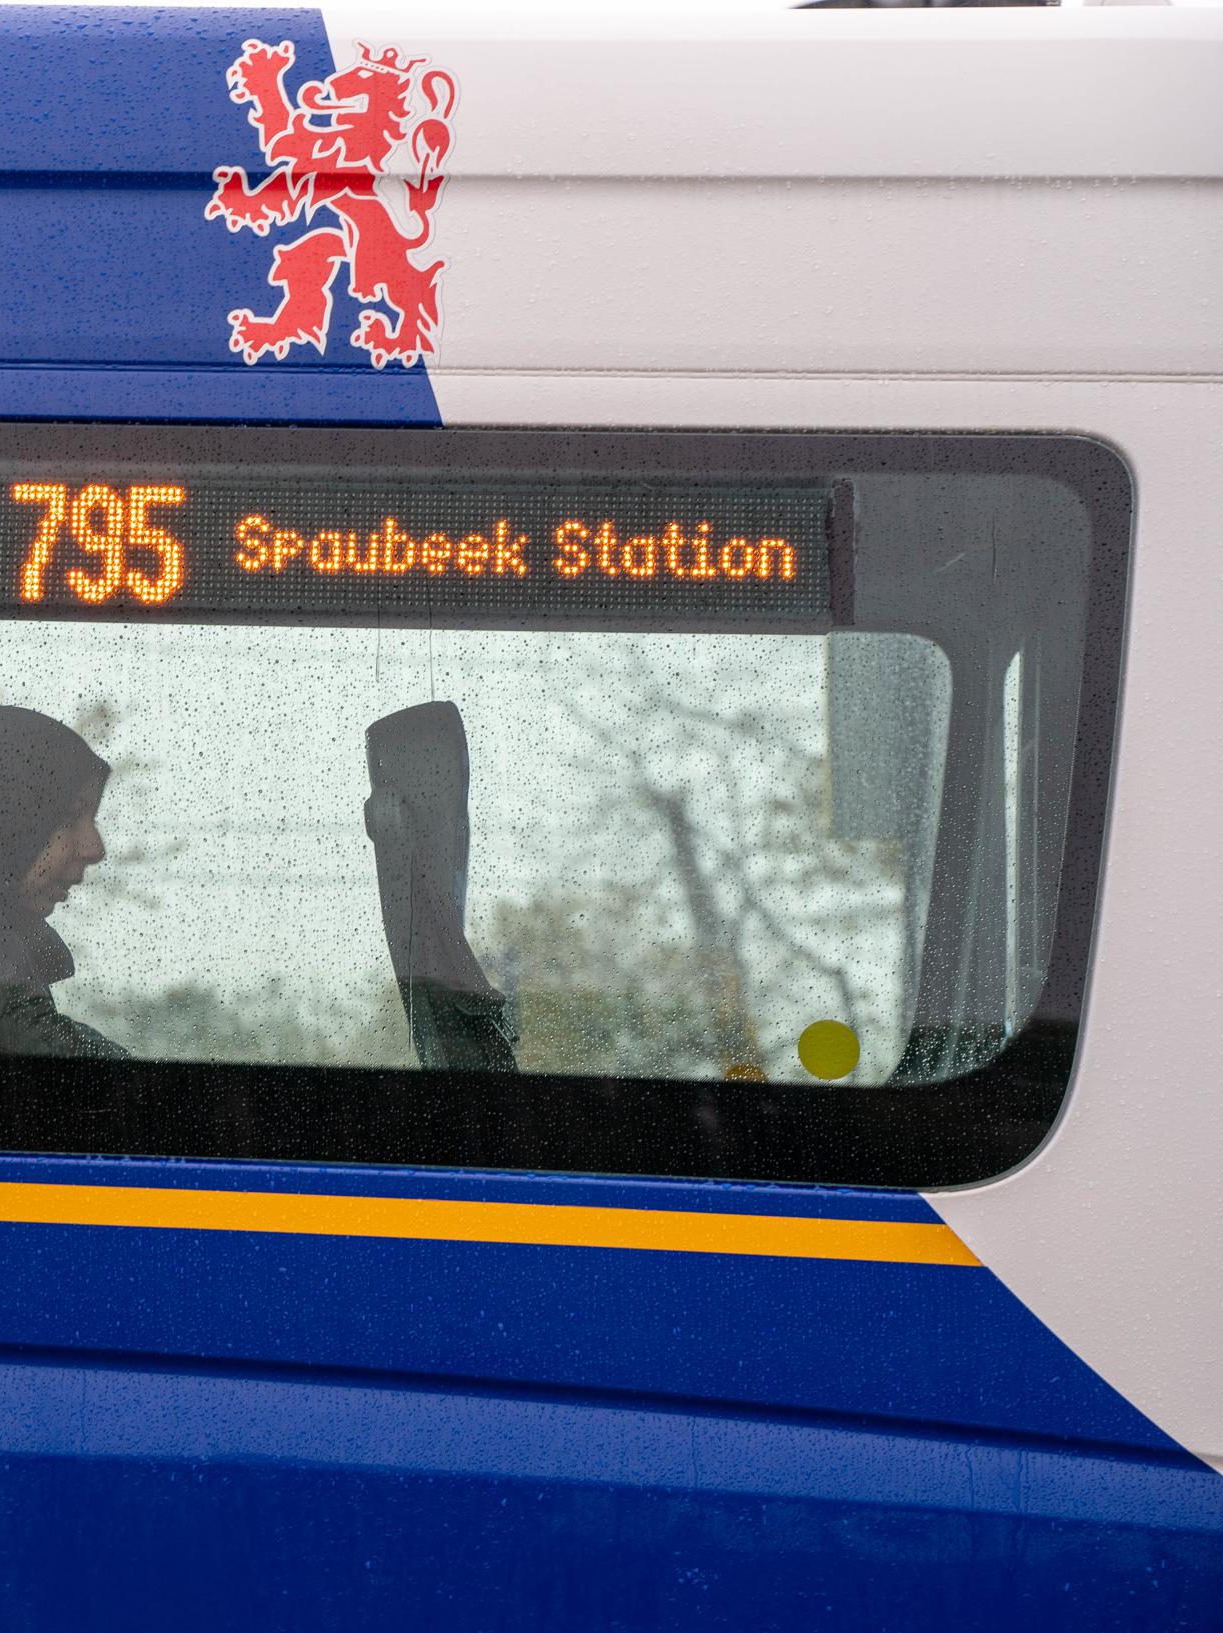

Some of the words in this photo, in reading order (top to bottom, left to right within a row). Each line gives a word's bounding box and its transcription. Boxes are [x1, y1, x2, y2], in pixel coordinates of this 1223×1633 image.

[10, 481, 187, 607] 795
[233, 512, 529, 578] Spaubeek
[552, 518, 795, 581] Station
